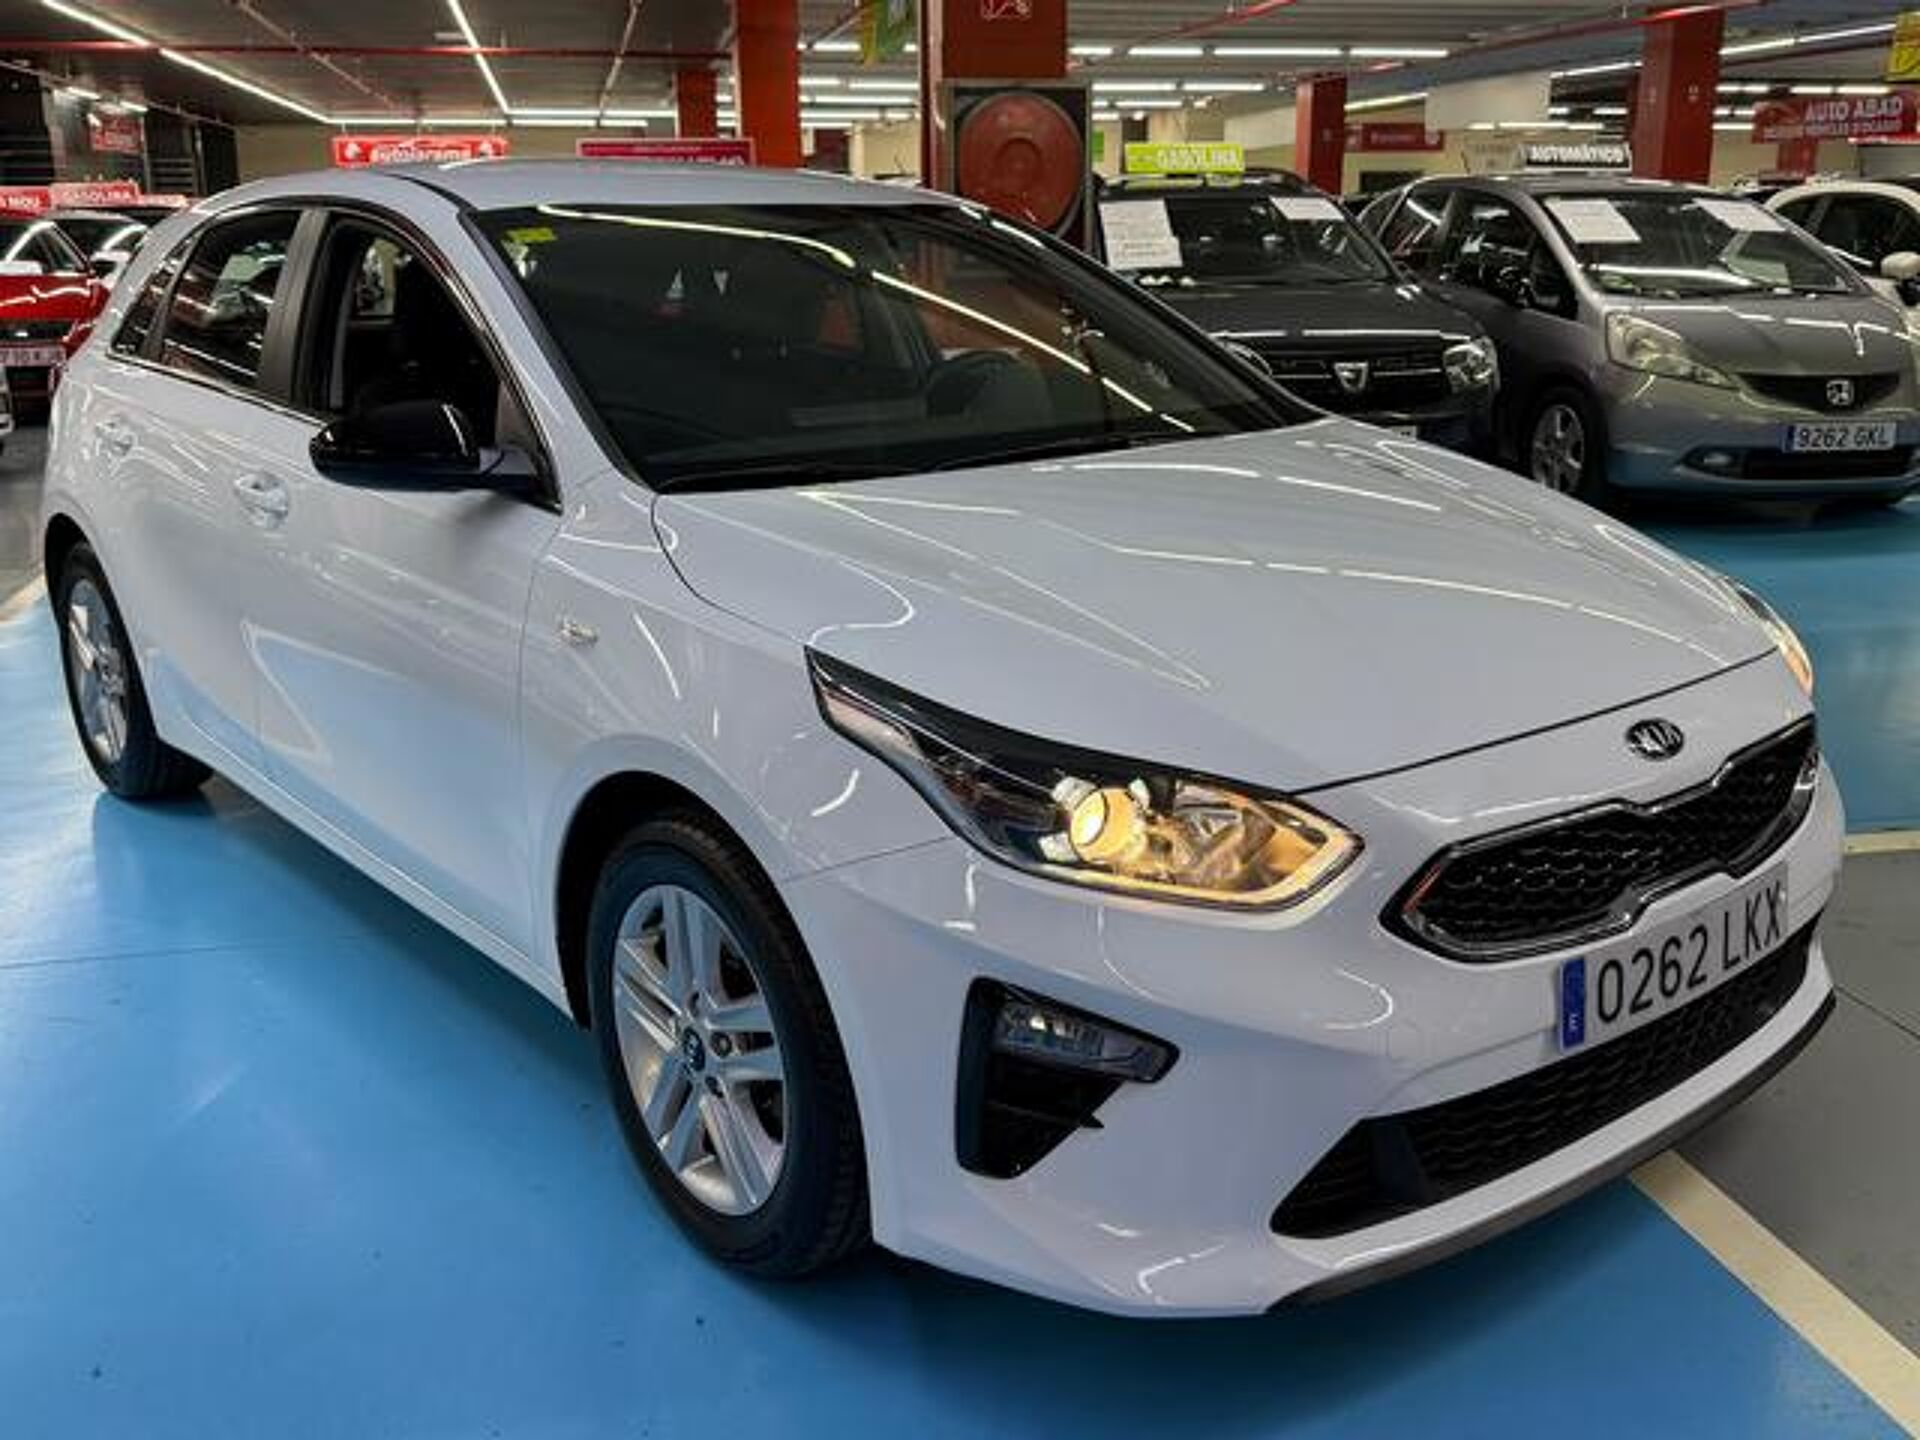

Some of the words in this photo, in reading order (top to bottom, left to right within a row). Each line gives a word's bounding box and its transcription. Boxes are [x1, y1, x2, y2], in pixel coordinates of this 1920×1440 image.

[1805, 100, 1849, 121] AUTO
[1854, 97, 1903, 117] ABAD
[1157, 148, 1238, 170] GASOLINA
[1798, 426, 1849, 448] 9262
[1854, 425, 1887, 447] GKL
[1598, 923, 1708, 1024] 0262
[1721, 879, 1782, 971] LKX
